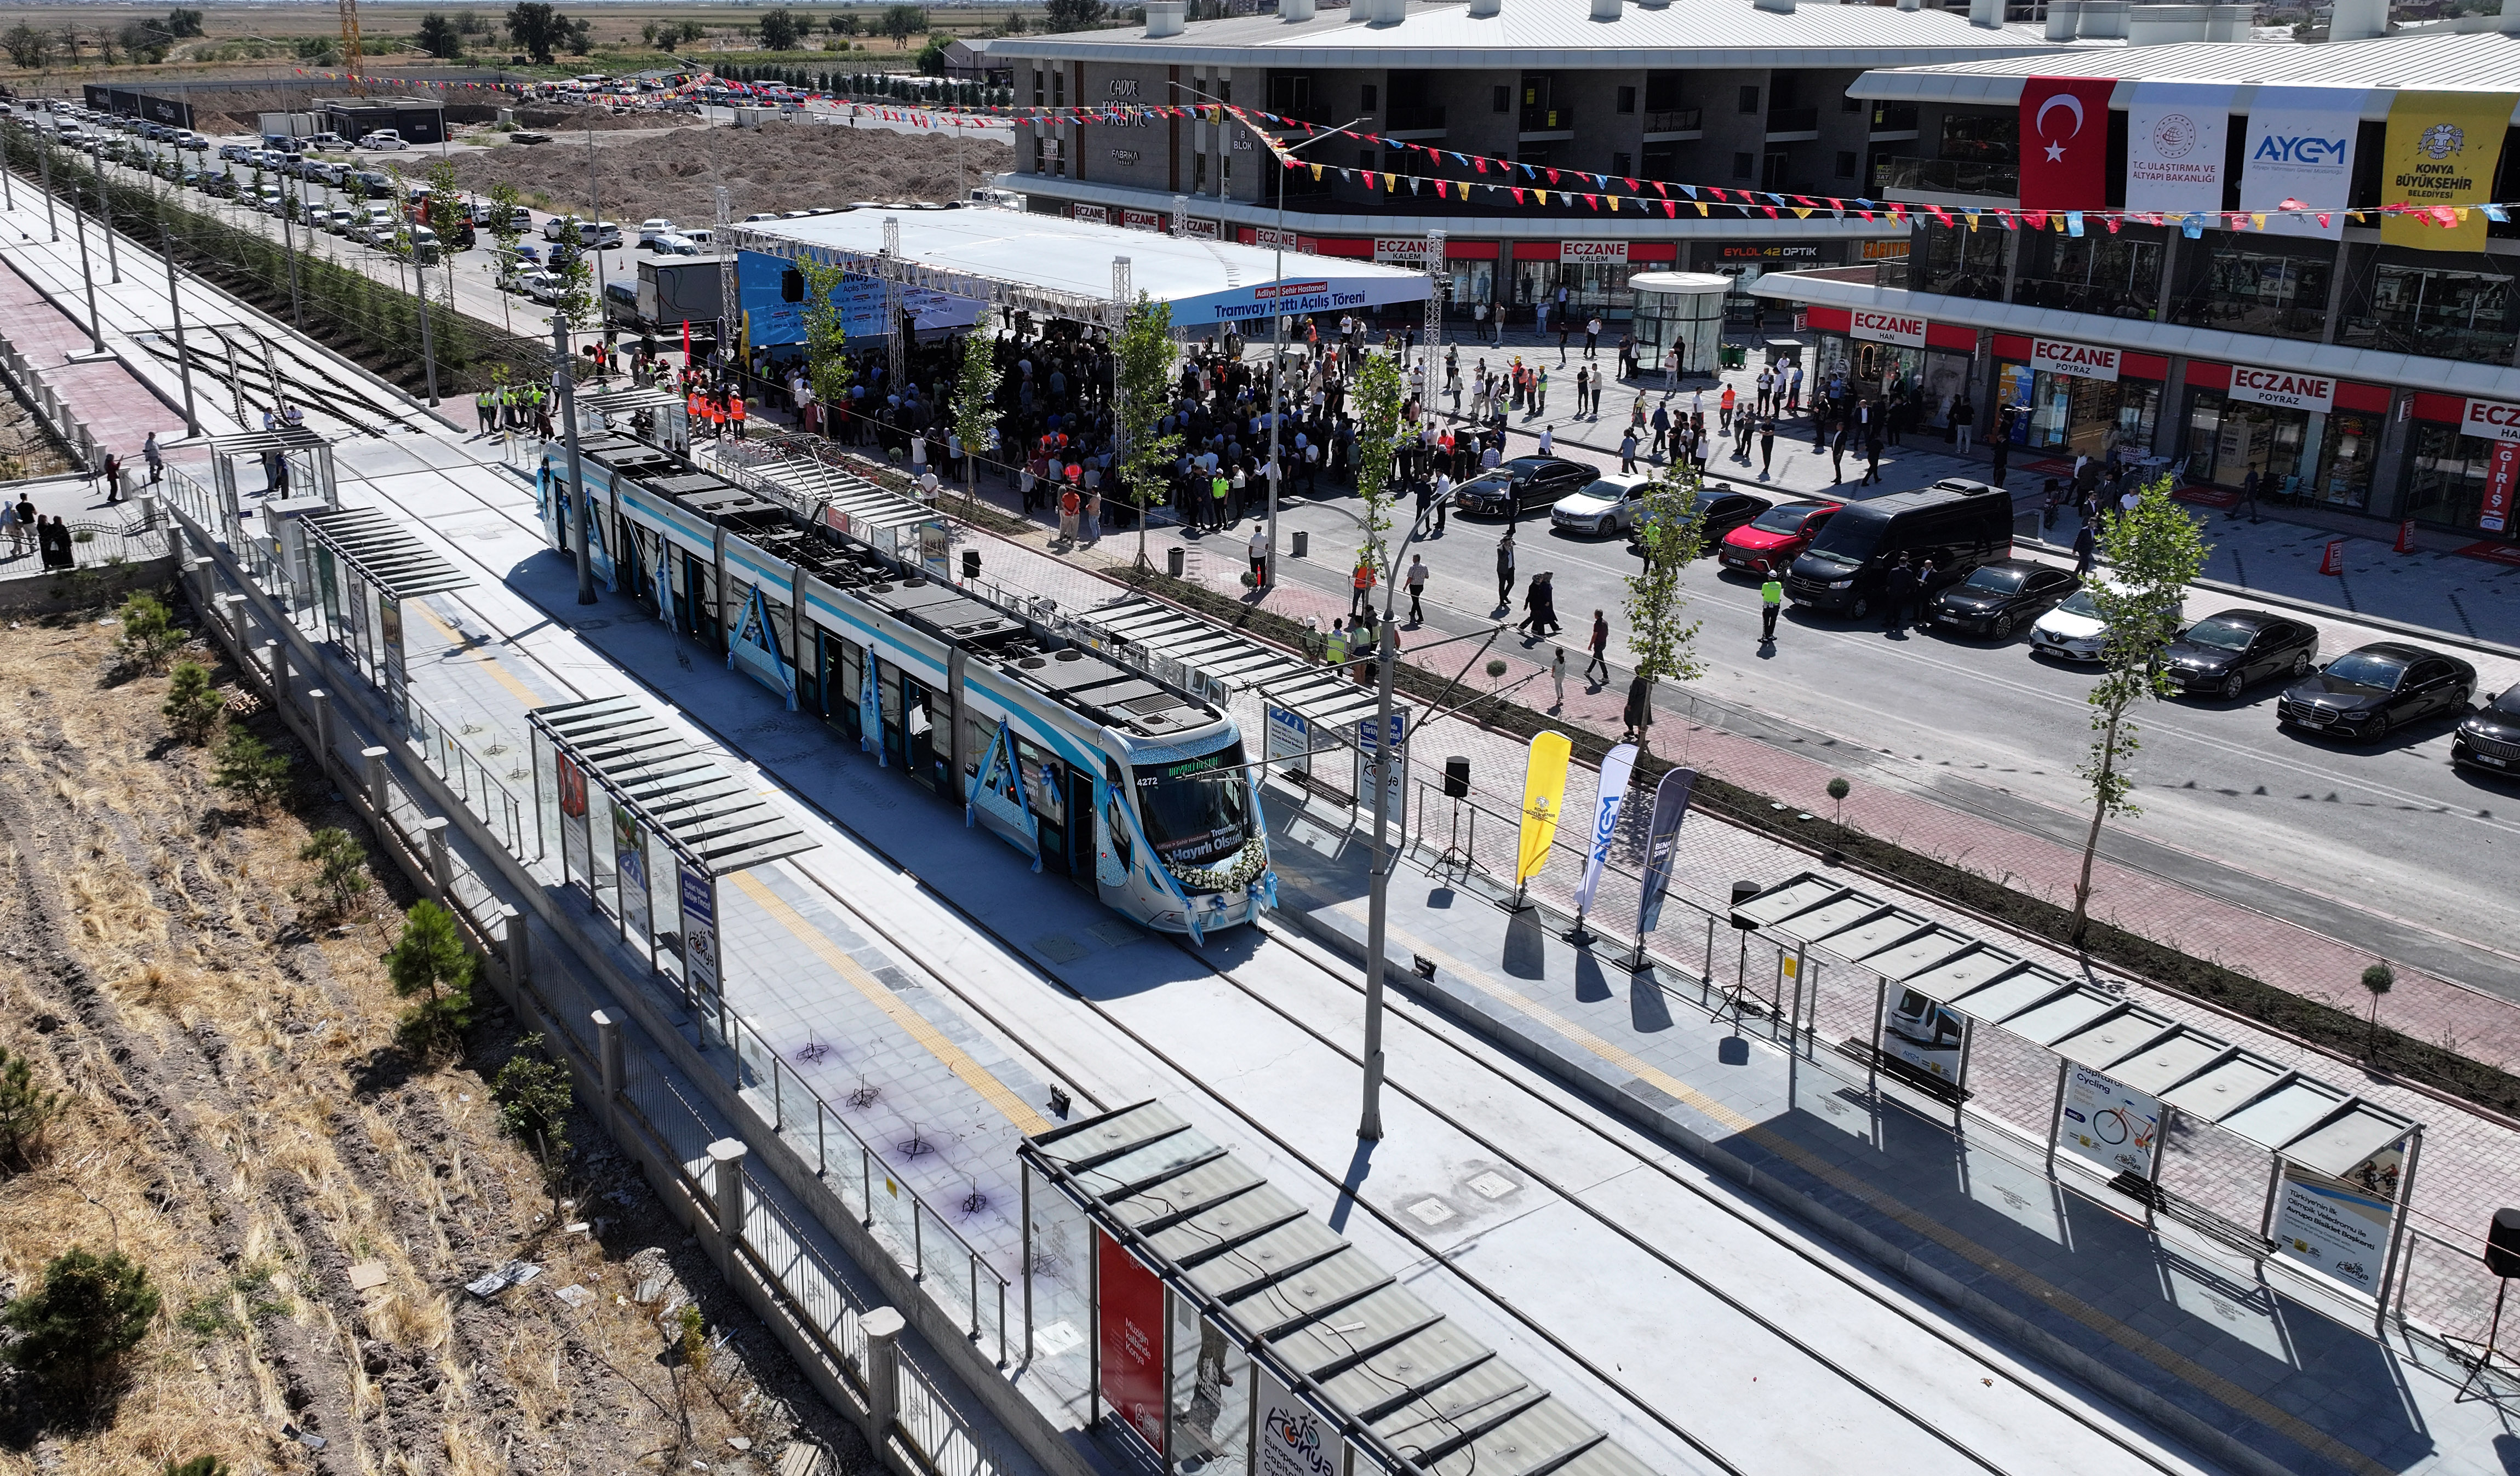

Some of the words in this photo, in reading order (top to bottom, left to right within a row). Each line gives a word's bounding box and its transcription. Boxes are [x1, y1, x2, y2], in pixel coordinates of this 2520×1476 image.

[1110, 79, 1138, 96] CADDE
[1241, 130, 1245, 139] B
[1234, 141, 1252, 151] BLOK
[2253, 135, 2346, 164] AYGM
[2133, 161, 2146, 169] T.C.
[2148, 163, 2201, 173] ULAŞTIRMA
[2415, 164, 2454, 174] KONYA
[2133, 171, 2164, 181] ALTYAPI
[2166, 174, 2215, 183] BAKANLIĞI
[2396, 173, 2472, 190] BÜYÜKŞEHİR
[2408, 189, 2453, 199] BELEDİYESİ
[1075, 206, 1104, 219] ECZANE
[1125, 212, 1156, 226] ECZANE
[1563, 243, 1625, 255] ECZANE
[1724, 247, 1762, 256] EYLÜL
[1763, 248, 1780, 256] 42
[1863, 242, 1910, 258] SARIYE
[1257, 289, 1275, 298] Adliye
[1282, 287, 1297, 296] Şehir
[1298, 283, 1326, 293] Hastanesi
[1215, 302, 1266, 318] Tramvay
[1269, 300, 1297, 313] Hattı
[1300, 296, 1330, 311] Açılış
[1332, 290, 1365, 305] Töreni
[1854, 312, 1923, 336] ECZANE
[1879, 332, 1894, 341] HAN
[2035, 341, 2115, 368] ECZANE
[2056, 363, 2091, 374] POYRAZ
[2235, 369, 2329, 399] ECZANE
[2259, 393, 2299, 405] POYRAZ
[2501, 428, 2520, 439] HA
[1362, 725, 1378, 737] Türkiy
[1137, 777, 1158, 786] 4272
[1172, 842, 1212, 860] Hayırlı
[2077, 1073, 2110, 1094] Cycling
[2289, 1189, 2328, 1211] Türkiye'nin
[2288, 1198, 2316, 1215] Olimpik
[2317, 1210, 2357, 1233] Veledromu
[2358, 1229, 2367, 1238] ile
[2286, 1205, 2313, 1222] Avrupa
[2313, 1217, 2341, 1235] Bisiklet
[2341, 1231, 2375, 1250] Başkenti
[2336, 1261, 2369, 1280] Konya
[1126, 1317, 1149, 1346] Müziğin
[1126, 1329, 1151, 1360] kalbinde
[1126, 1341, 1144, 1366] Konya
[1265, 1406, 1334, 1476] Konya
[1265, 1434, 1304, 1476] European
